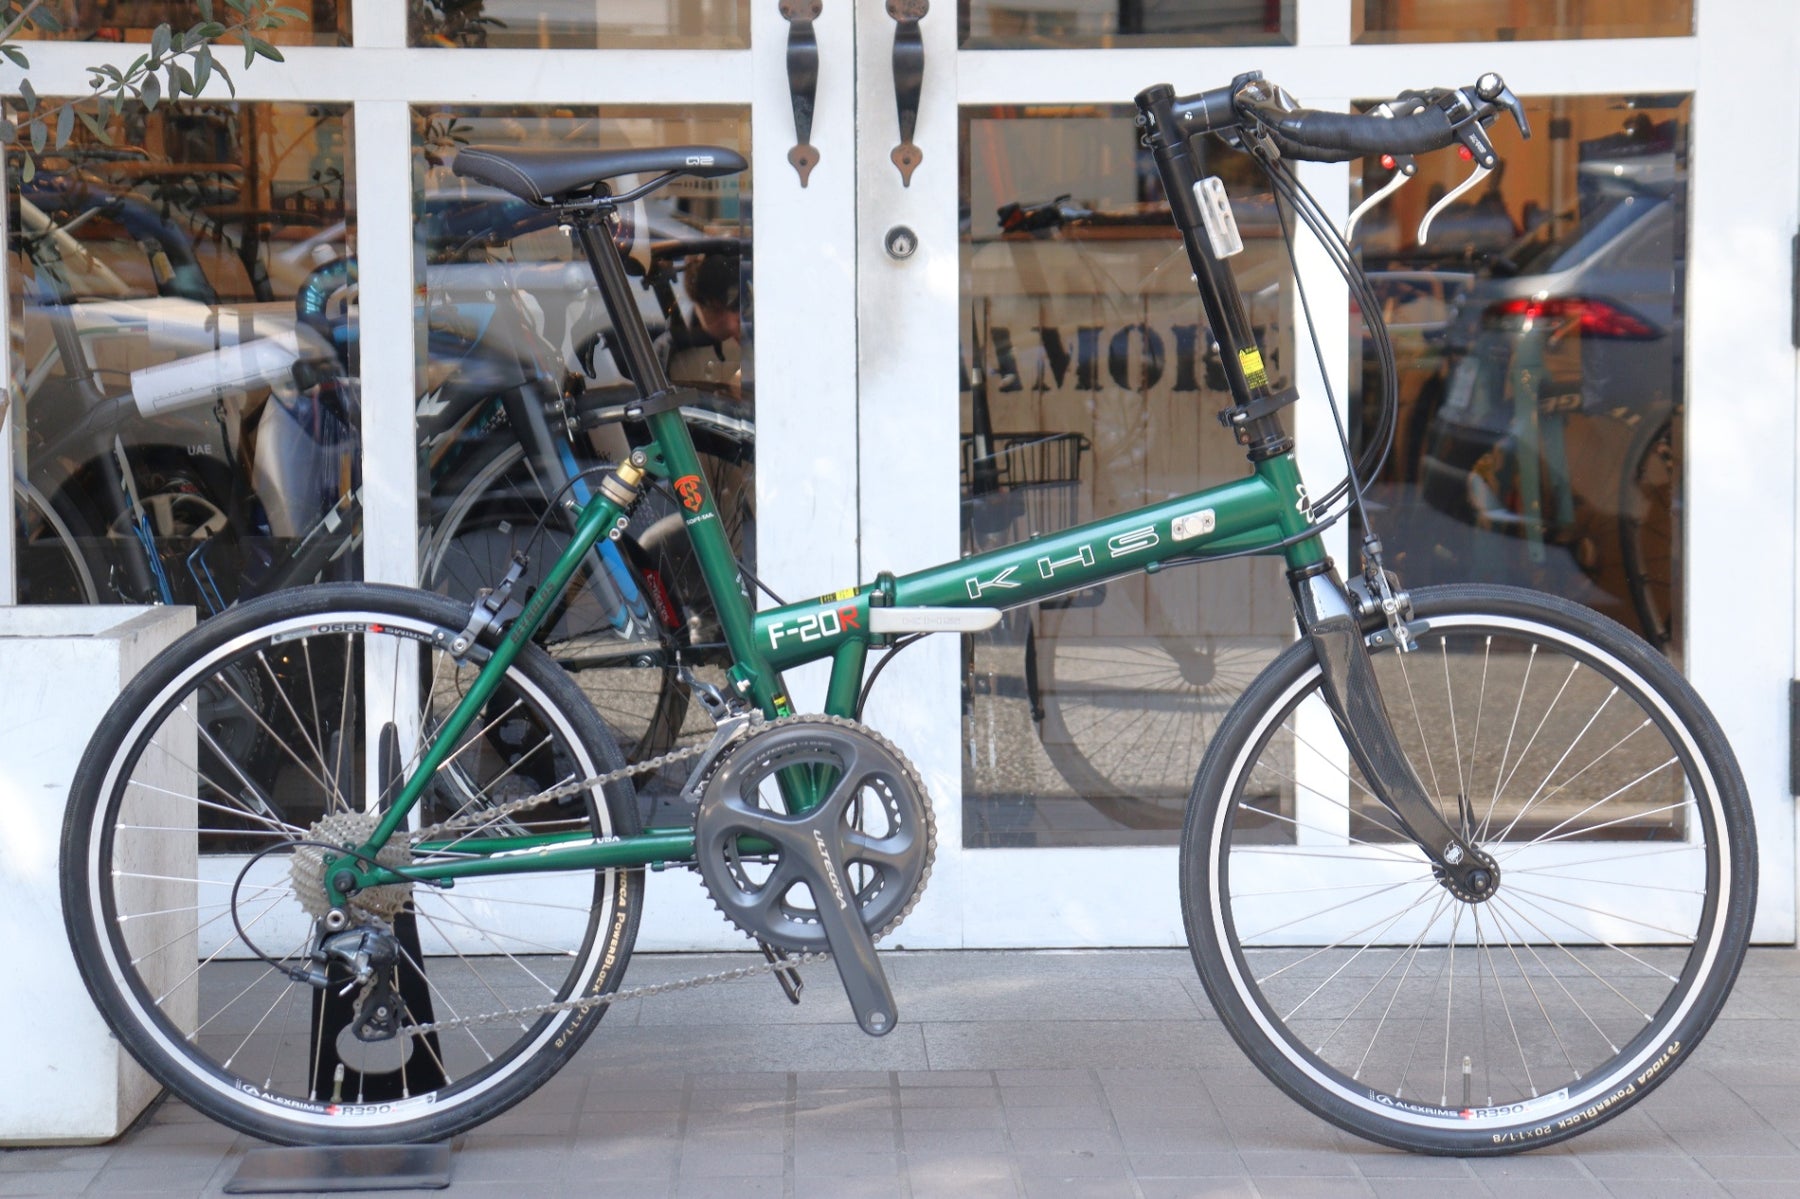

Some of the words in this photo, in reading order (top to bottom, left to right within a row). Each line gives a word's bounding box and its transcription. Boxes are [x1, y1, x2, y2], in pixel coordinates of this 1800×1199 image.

[187, 444, 212, 456] UAE
[966, 524, 1160, 600] KHS
[384, 626, 433, 642] EXRIMS
[767, 604, 860, 650] F-20R
[813, 829, 848, 910] ULTEGRA
[261, 1092, 326, 1113] ALEXRIMS
[341, 1104, 392, 1116] R390
[1394, 1102, 1459, 1118] ALEXRIMS
[1476, 1104, 1524, 1119] R390
